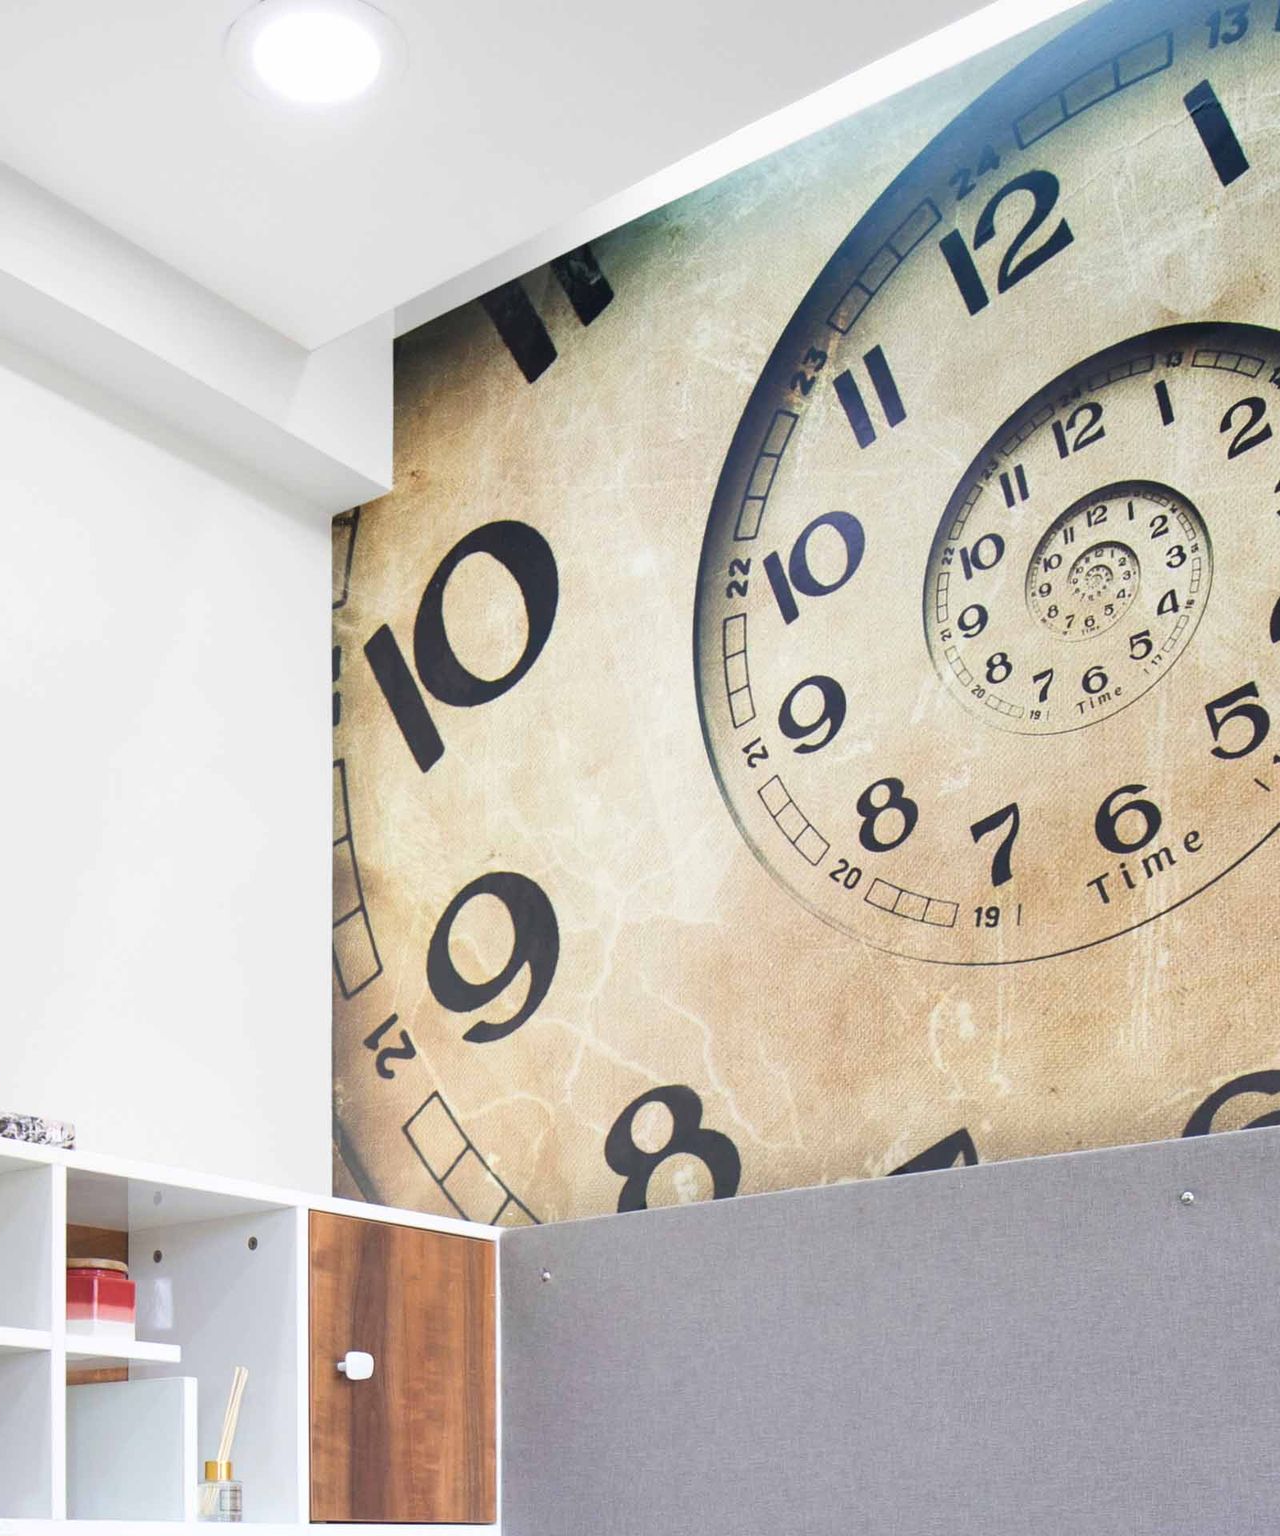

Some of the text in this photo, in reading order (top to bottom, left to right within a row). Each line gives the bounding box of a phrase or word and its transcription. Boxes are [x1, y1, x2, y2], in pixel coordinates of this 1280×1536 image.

[1205, 16, 1249, 48] 13
[1183, 79, 1249, 187] 1
[948, 145, 1002, 201] 24
[939, 167, 1074, 316] 12
[790, 345, 828, 396] 23
[1165, 350, 1183, 368] 13
[832, 344, 906, 449] 11
[1154, 380, 1174, 426] 1
[1050, 401, 1105, 459] 12
[1220, 397, 1272, 459] 2
[999, 463, 1029, 508] 11
[1086, 504, 1107, 527] 12
[1128, 501, 1134, 520] 1
[1150, 515, 1168, 539] 2
[1063, 527, 1074, 544] 11
[763, 511, 865, 625] 10
[942, 546, 955, 566] 22
[960, 533, 1005, 580] 10
[1043, 554, 1062, 572] 10
[1166, 545, 1186, 568] 3
[726, 558, 751, 599] 22
[1039, 583, 1052, 597] 9
[1047, 605, 1059, 618] 8
[1157, 589, 1179, 616] 4
[940, 629, 951, 641] 21
[958, 604, 988, 638] 9
[1066, 614, 1075, 628] 7
[1085, 615, 1095, 627] 6
[364, 520, 559, 773] 10
[1130, 630, 1152, 660] 5
[986, 652, 1012, 684] 8
[1082, 666, 1108, 694] 6
[971, 685, 985, 698] 20
[1033, 668, 1053, 702] 7
[1076, 686, 1122, 715] Time
[778, 675, 846, 754] 9
[1030, 710, 1041, 720] 19
[1205, 681, 1270, 759] 5
[742, 737, 768, 767] 21
[857, 778, 918, 852] 8
[1095, 784, 1161, 854] 6
[970, 803, 1019, 887] 7
[829, 859, 862, 889] 20
[1086, 831, 1204, 905] Time
[974, 906, 1000, 928] 19
[426, 872, 560, 1043] 9
[364, 1014, 416, 1079] 21
[605, 1085, 741, 1213] 8
